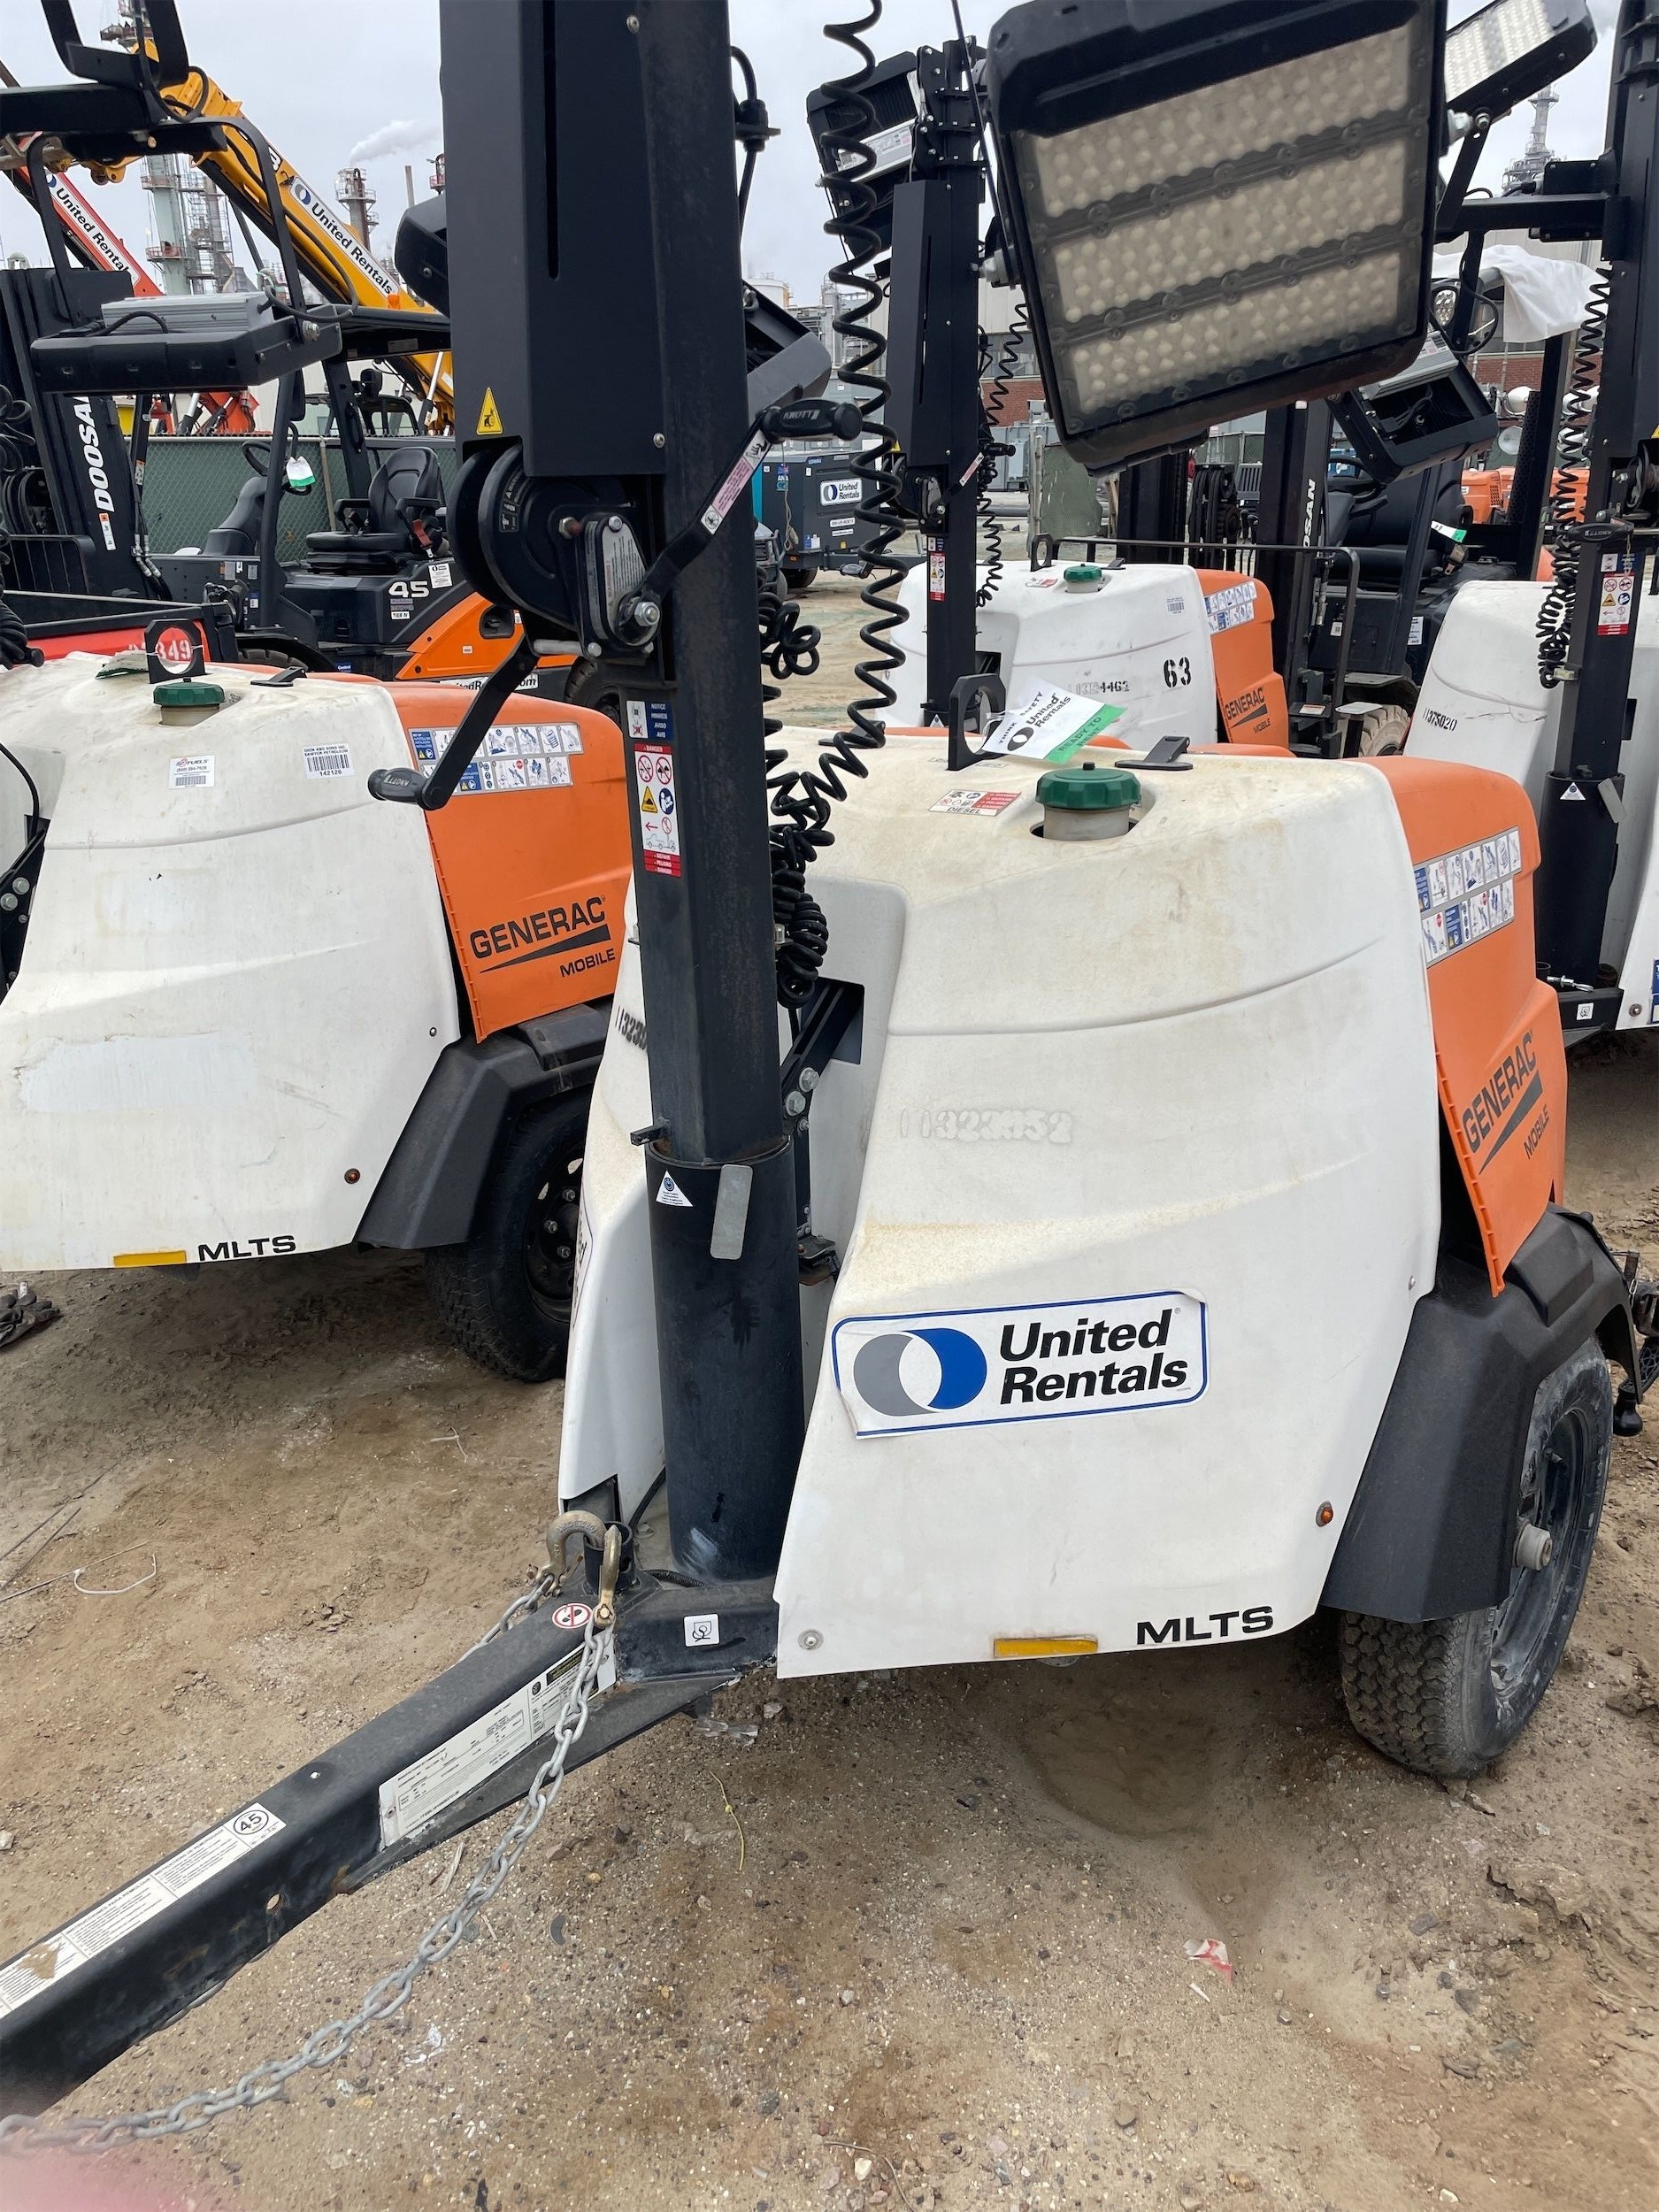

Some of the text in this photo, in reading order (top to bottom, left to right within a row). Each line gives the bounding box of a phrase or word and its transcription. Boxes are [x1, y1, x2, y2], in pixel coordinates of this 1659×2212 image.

[56, 187, 130, 272] United Rental
[311, 203, 393, 295] United Rentals
[839, 482, 858, 491] United
[388, 580, 429, 598] 45
[1164, 657, 1192, 688] 63
[1025, 695, 1061, 725] United
[1033, 696, 1071, 728] Rentals
[1225, 687, 1265, 721] GENERAC
[998, 722, 1018, 744] THINK
[1057, 717, 1102, 752] READY TO
[1253, 718, 1271, 733] MOBILE
[470, 896, 606, 959] GENERAC
[559, 948, 616, 978] MOBILE
[1463, 1031, 1537, 1154] GENERAC
[1523, 1103, 1549, 1160] MOBILE
[197, 1234, 296, 1262] MLTS
[1000, 1308, 1172, 1361] United
[1000, 1353, 1187, 1405] Rentals
[1137, 1605, 1273, 1645] MLTS
[239, 1813, 263, 1832] 45
